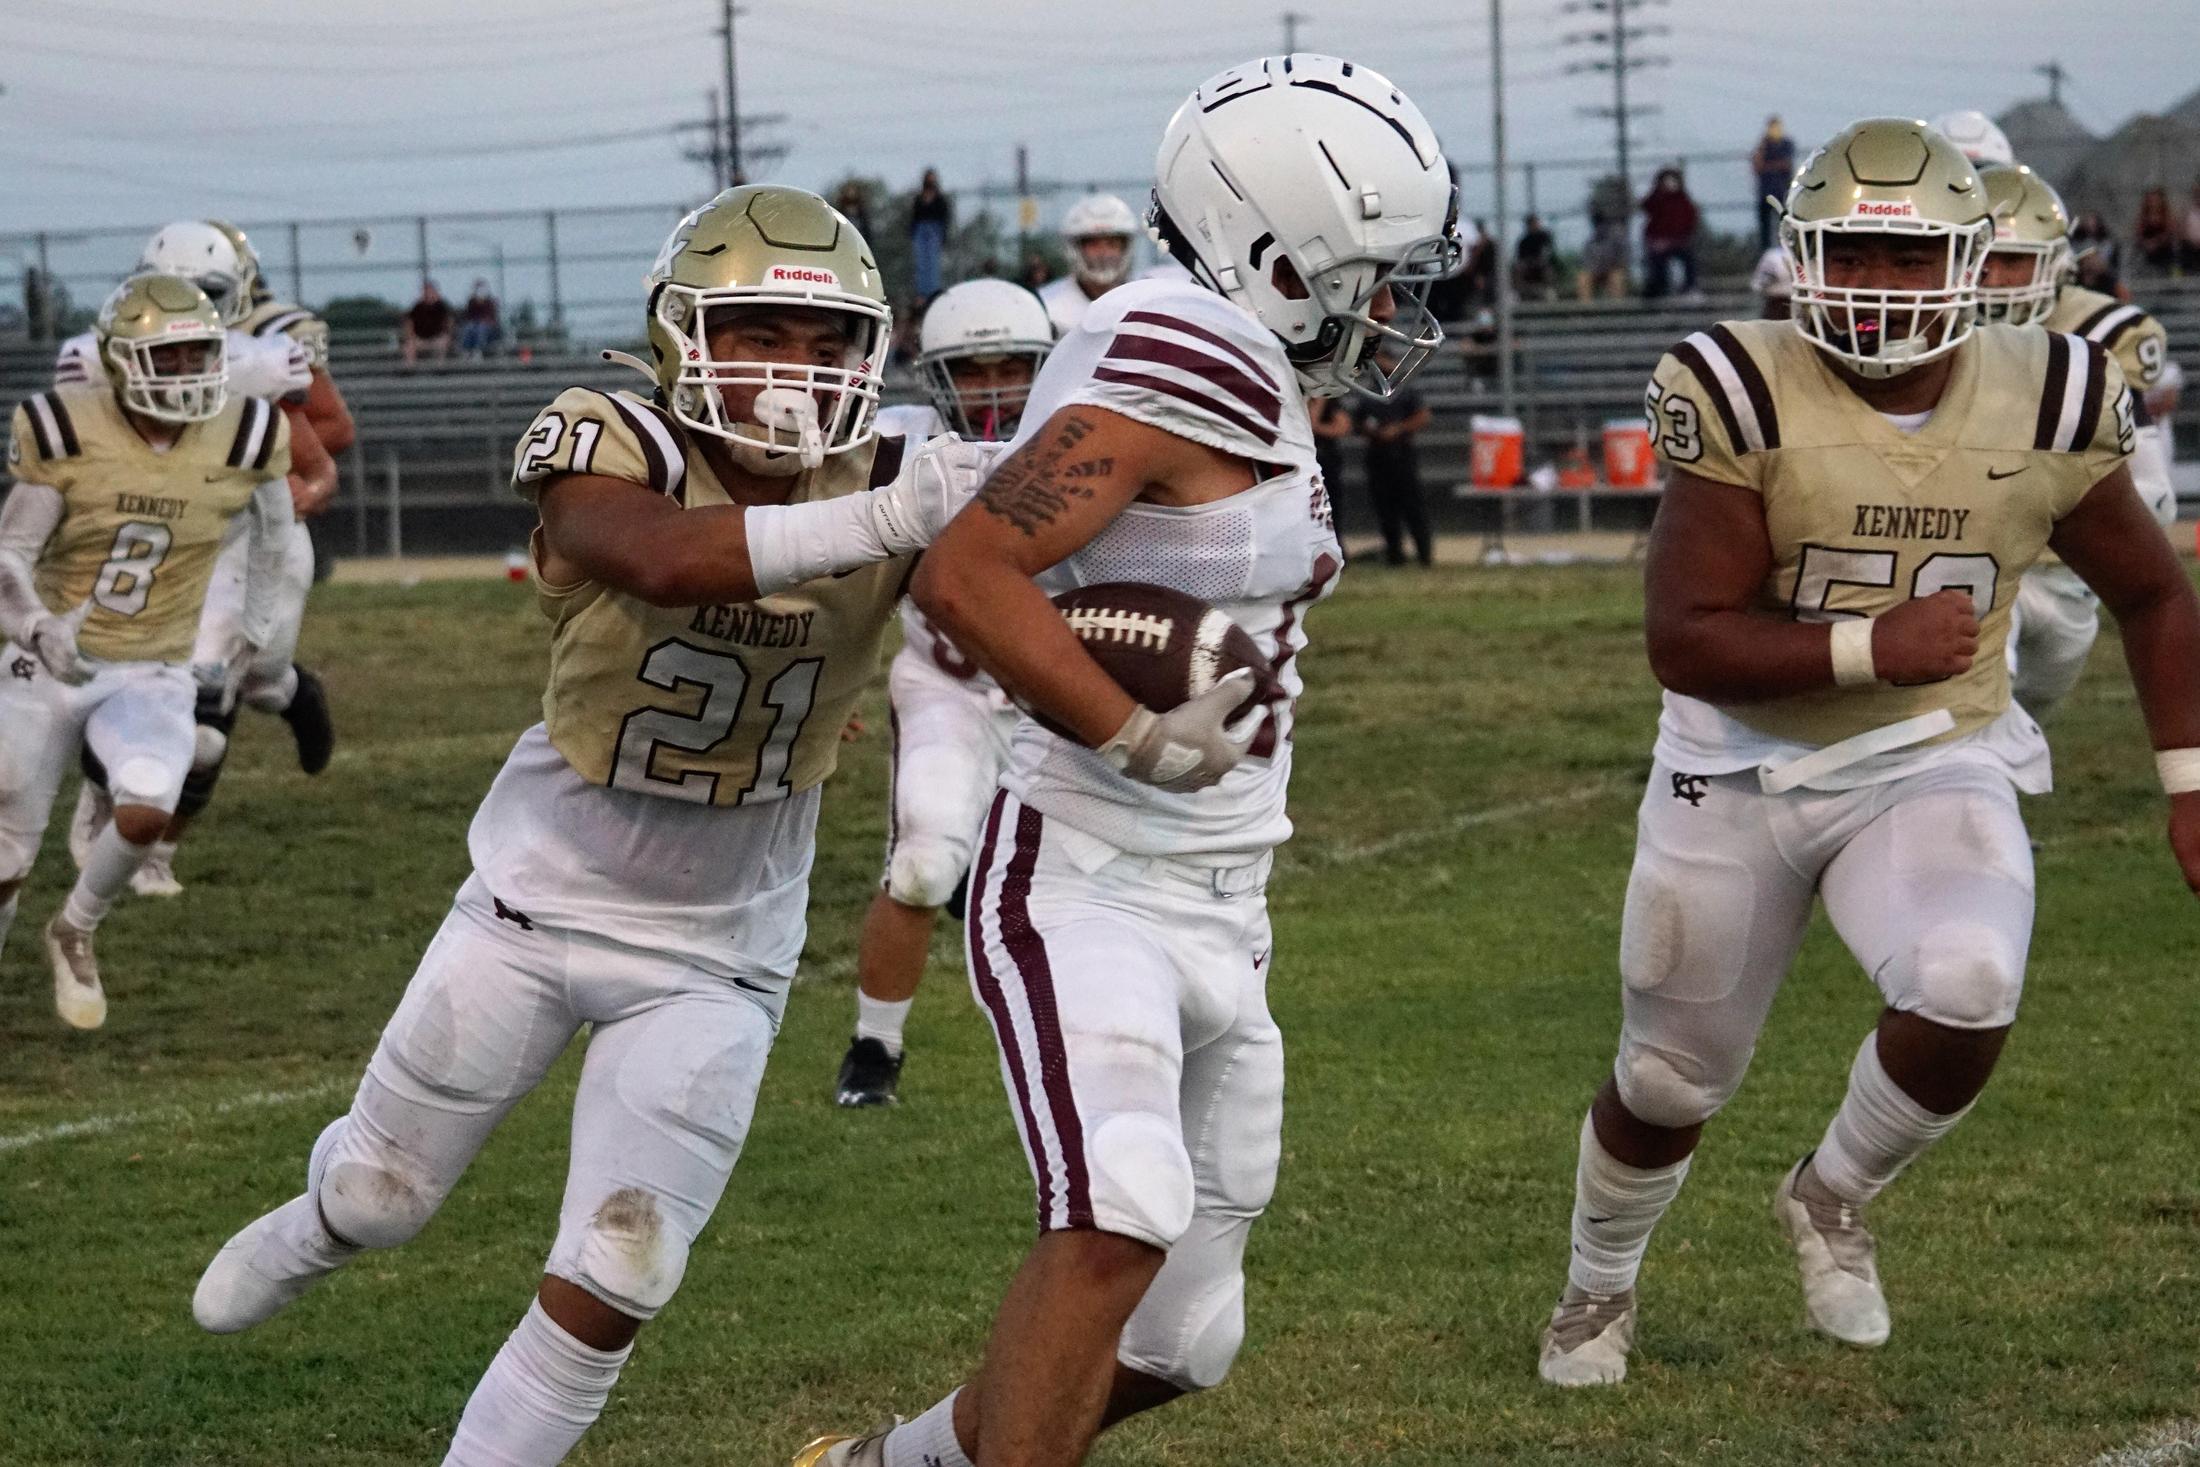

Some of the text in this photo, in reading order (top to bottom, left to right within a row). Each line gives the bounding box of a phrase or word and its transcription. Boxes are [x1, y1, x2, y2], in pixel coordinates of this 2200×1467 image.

[773, 268, 833, 284] Riddell
[2138, 335, 2164, 383] 9
[517, 411, 605, 483] 21
[116, 492, 190, 520] KENNEDY
[1852, 504, 1970, 541] KENNEDY
[92, 519, 174, 618] 8
[689, 604, 815, 648] KENNEDY
[607, 636, 825, 806] 21
